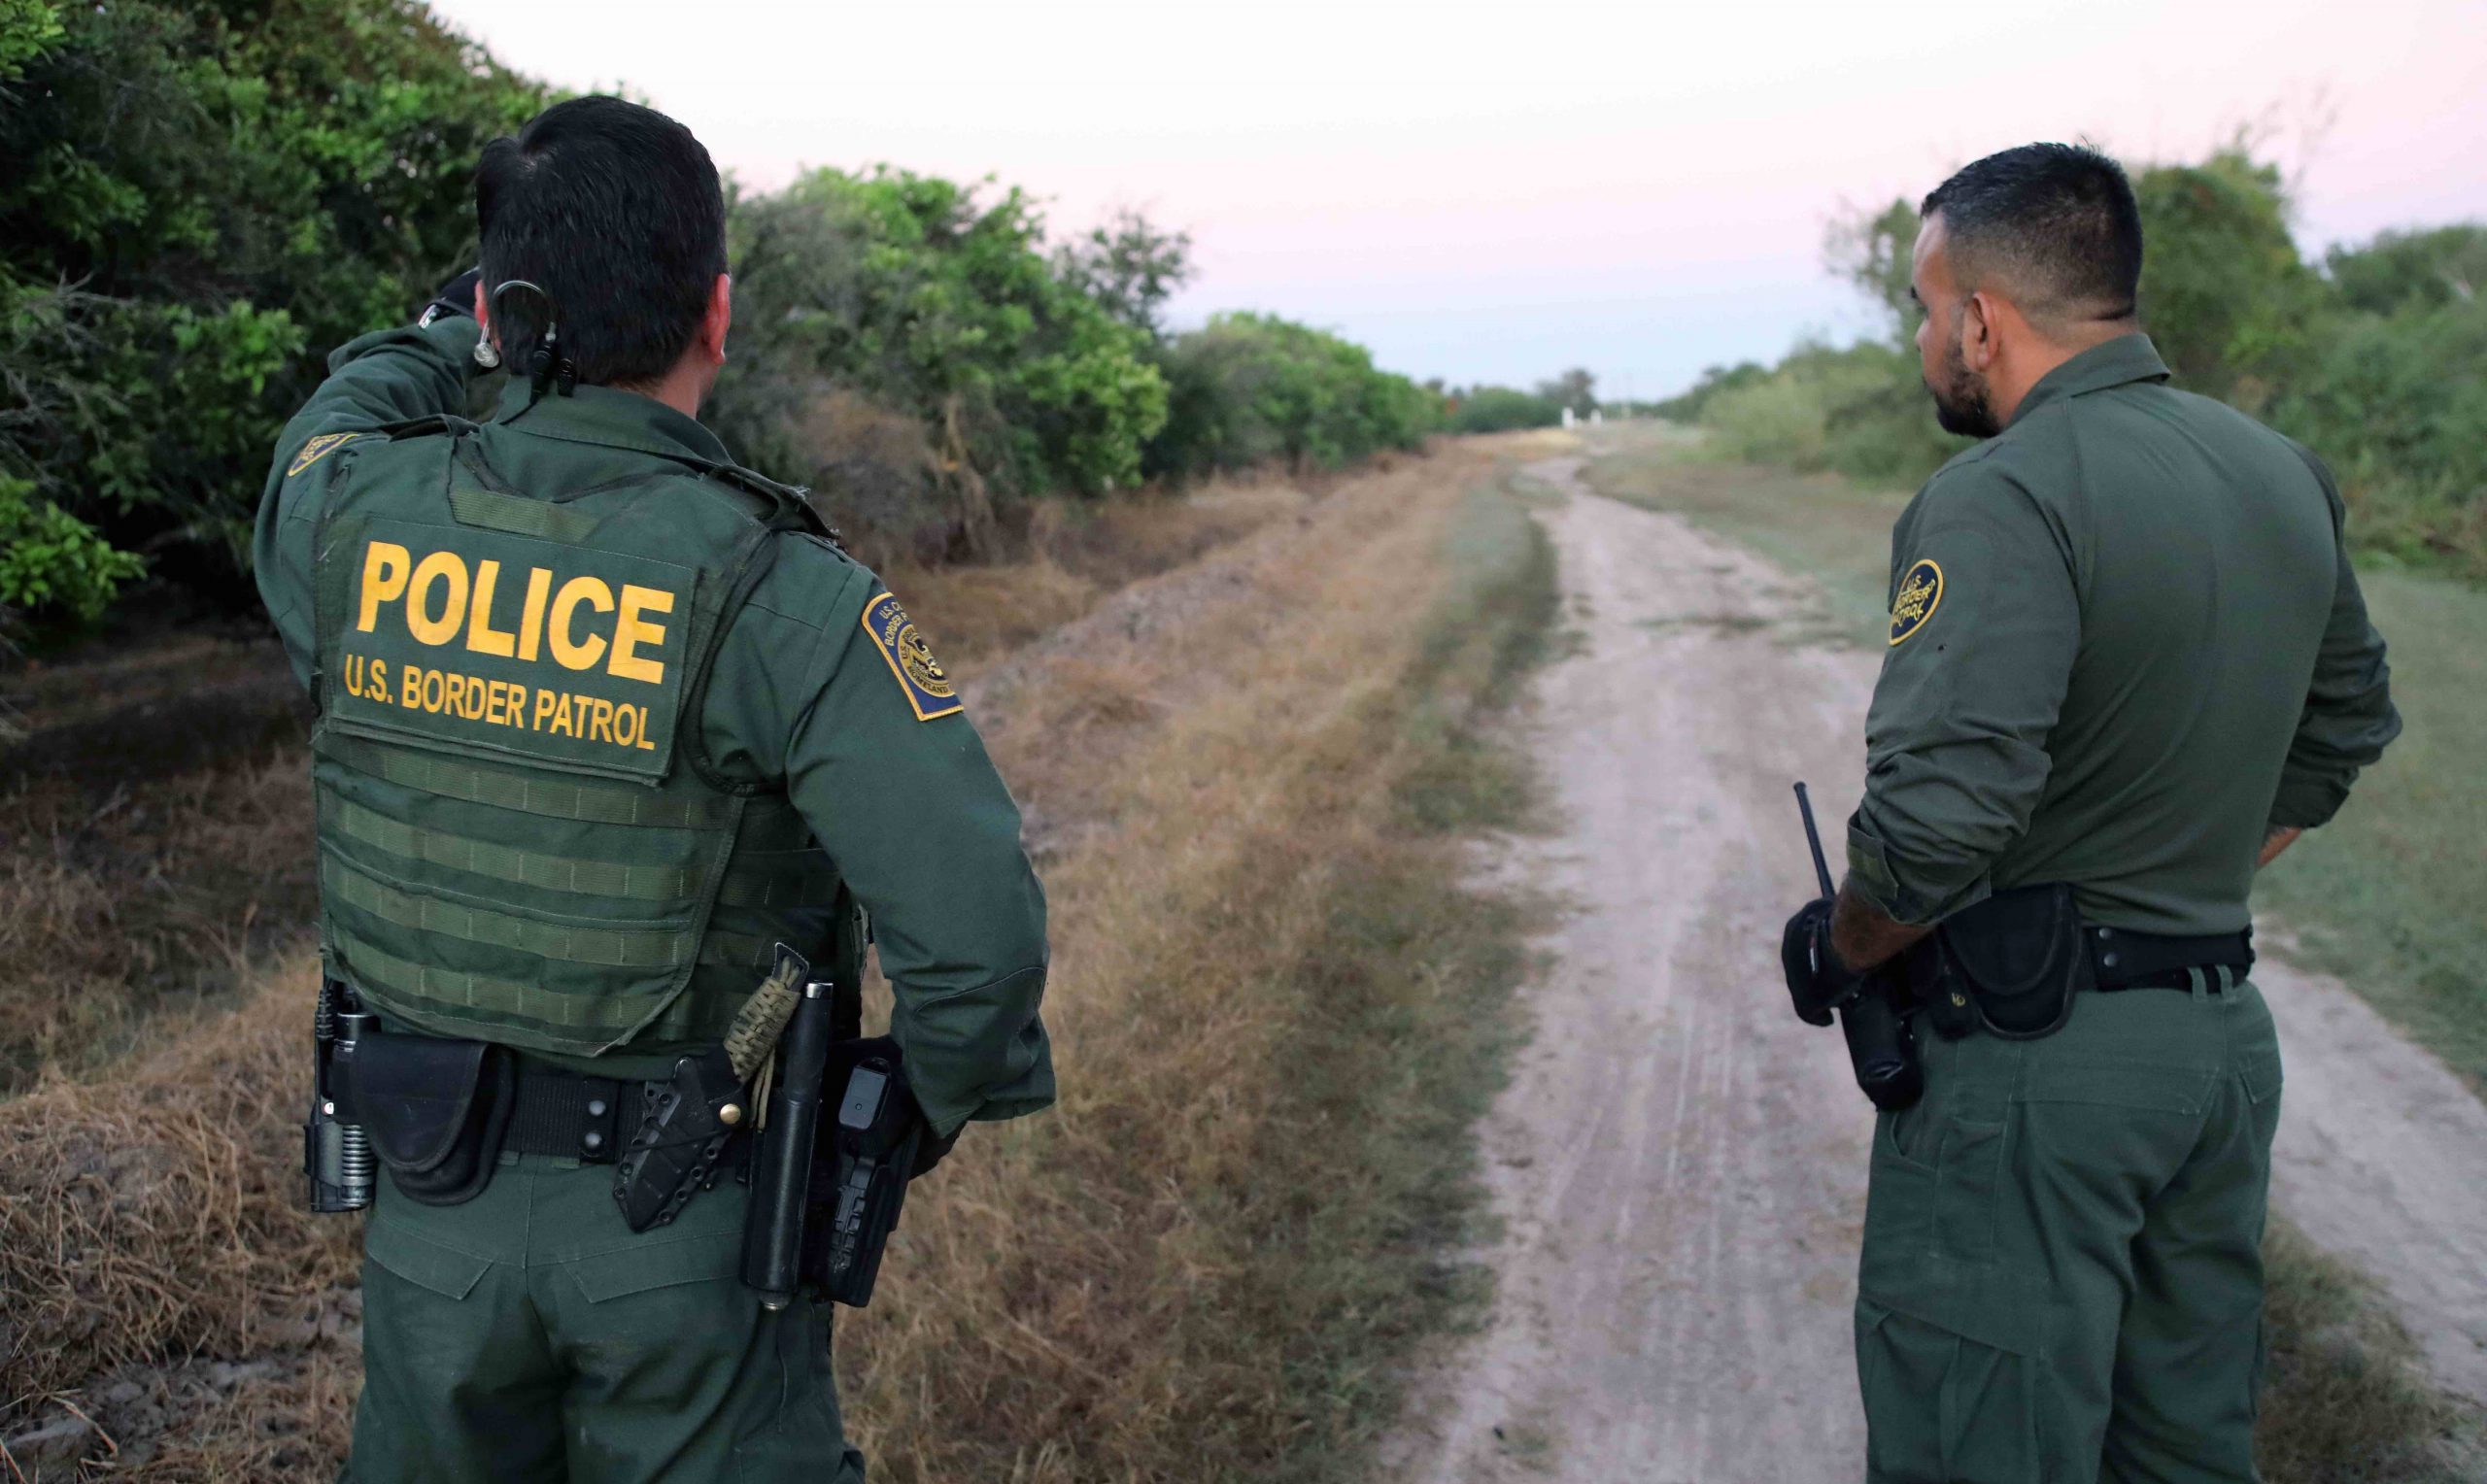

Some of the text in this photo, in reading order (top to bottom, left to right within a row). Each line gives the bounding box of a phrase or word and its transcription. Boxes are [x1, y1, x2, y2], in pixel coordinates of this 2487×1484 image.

[358, 541, 675, 684] POLICE
[345, 655, 655, 750] U.S. BORDER PATROL
